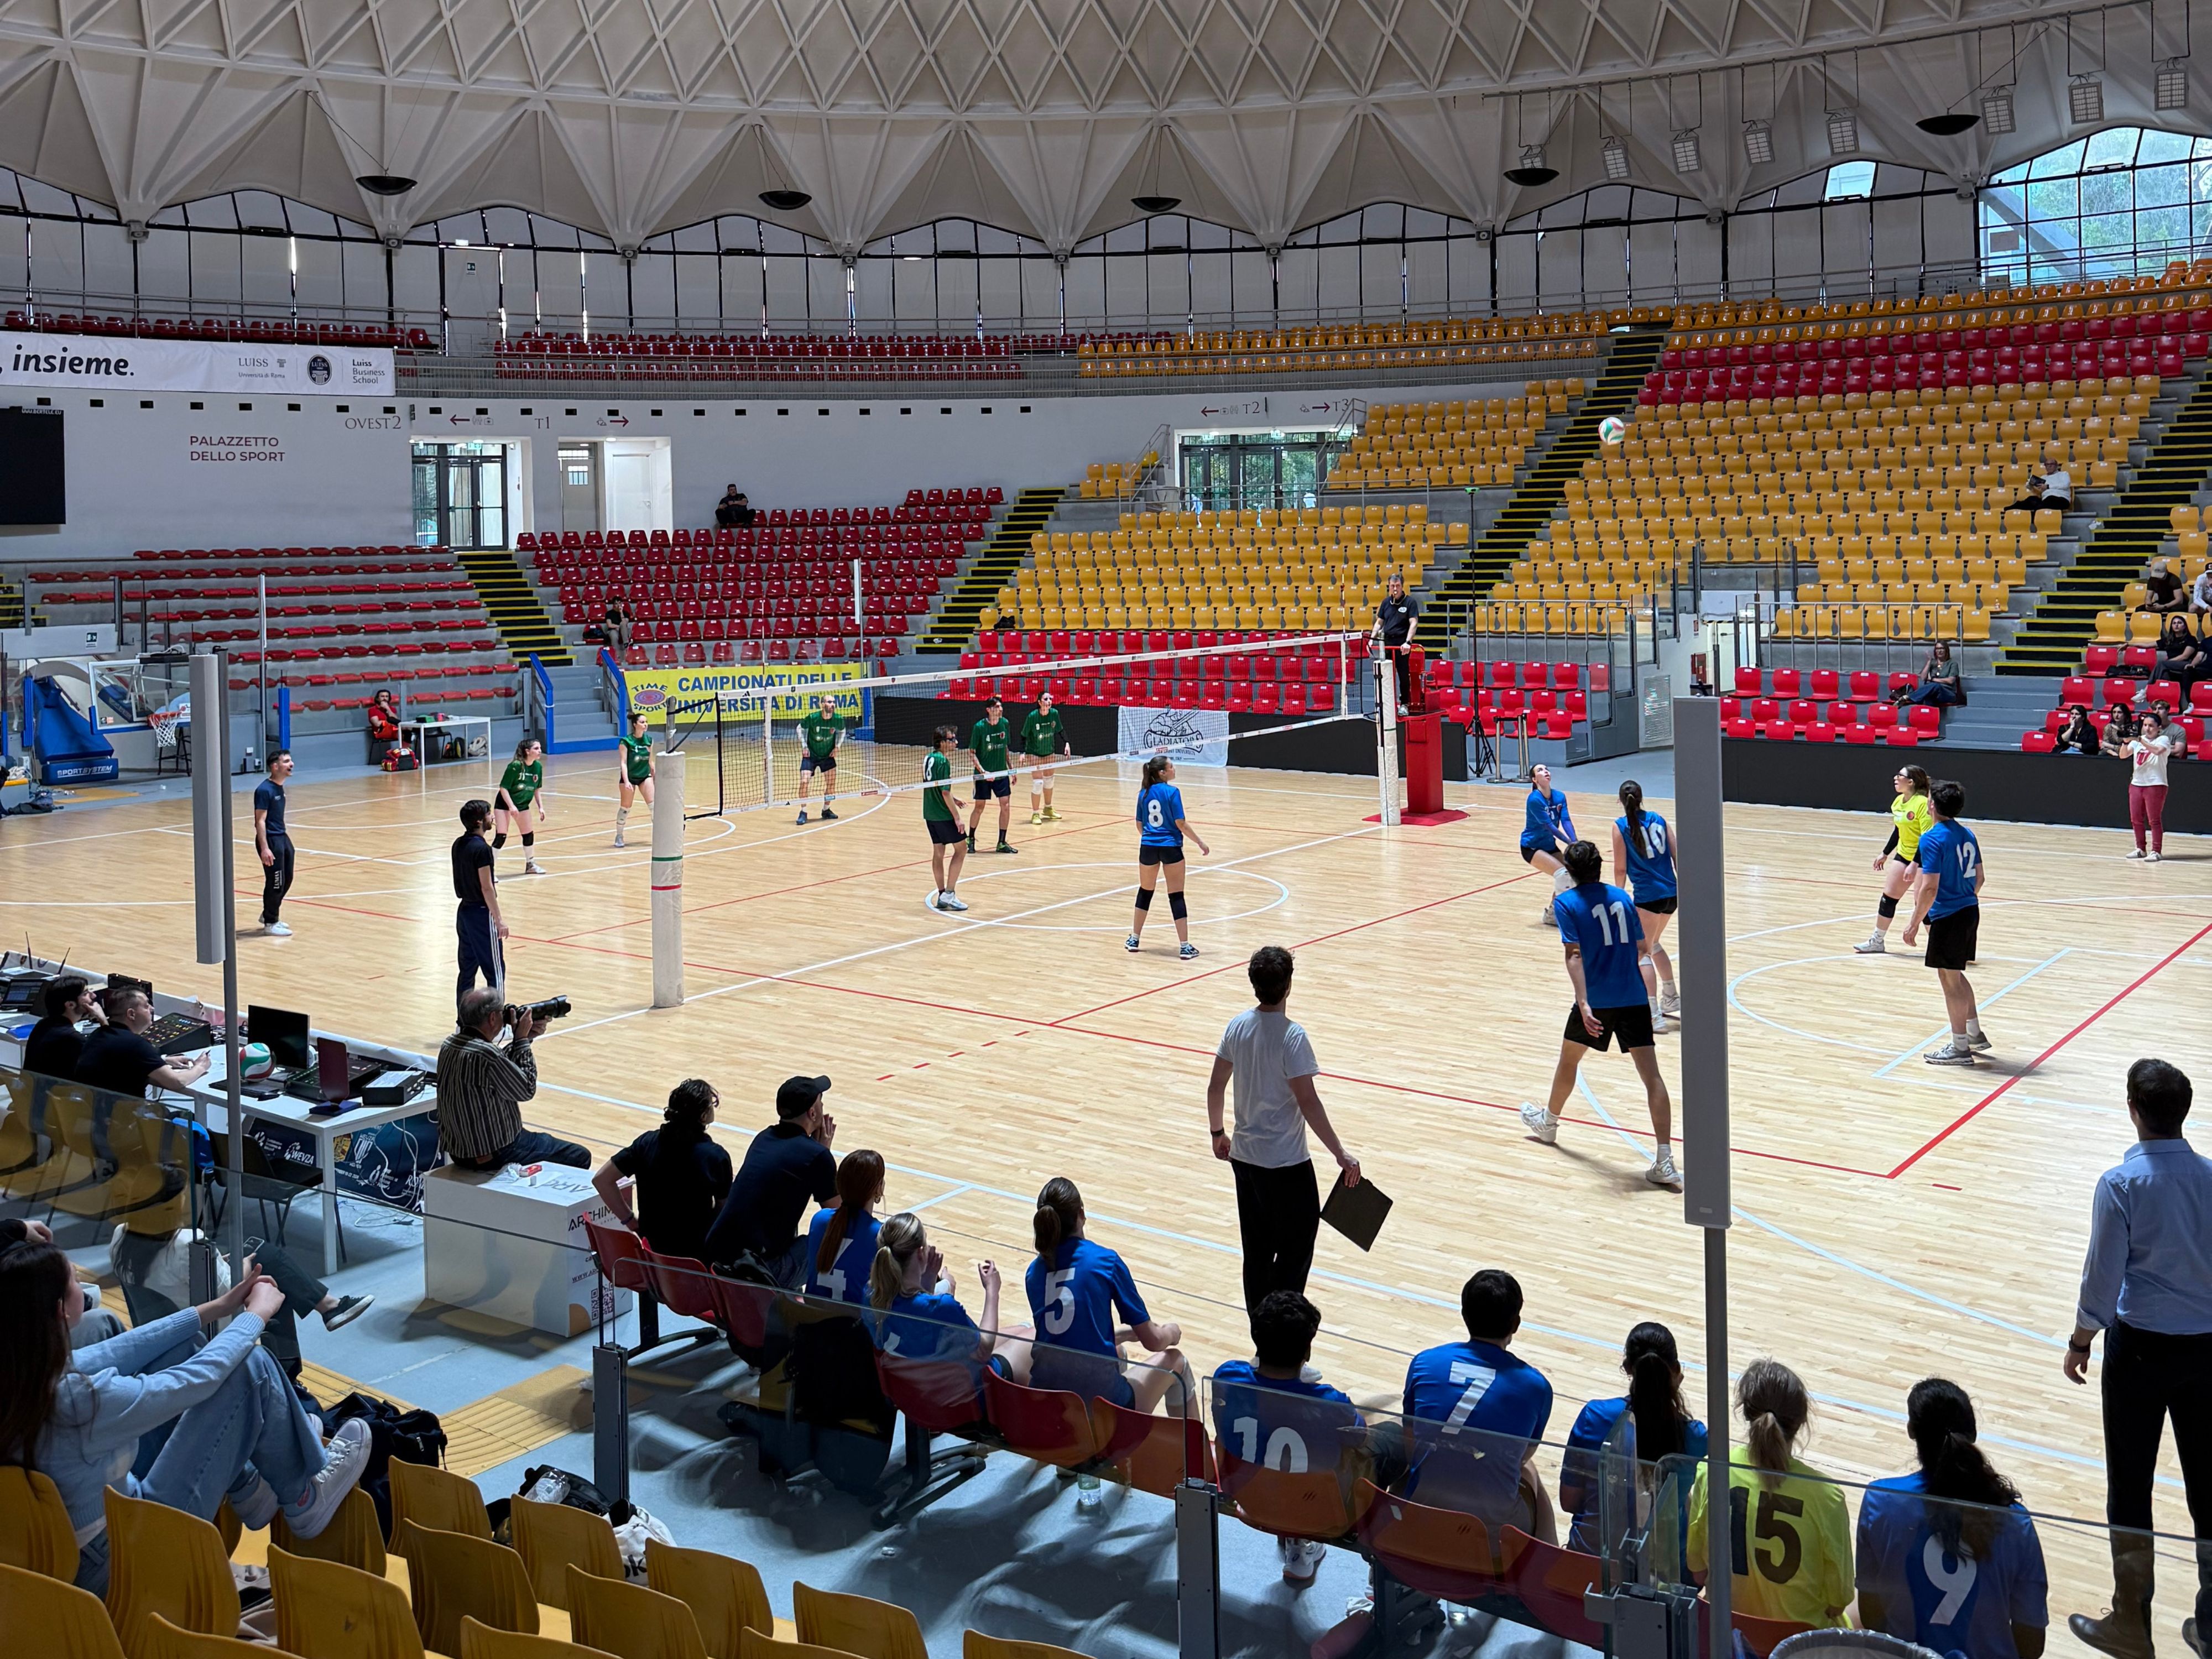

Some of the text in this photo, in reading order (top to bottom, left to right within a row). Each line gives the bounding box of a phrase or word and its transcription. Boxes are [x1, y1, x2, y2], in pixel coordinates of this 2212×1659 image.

[13, 344, 134, 376] insieme.
[238, 358, 268, 367] LUISS
[352, 367, 385, 376] Business
[1243, 401, 1260, 414] T2
[534, 416, 550, 429] T1
[190, 436, 279, 447] PALAZZETTO
[190, 451, 285, 462] DELLO SPORT
[632, 683, 669, 692] TIME
[678, 674, 792, 692] CAMPIONATI
[785, 695, 802, 709] DI
[809, 693, 859, 709] RMA
[1148, 799, 1164, 827] 8
[1641, 822, 1666, 859] 10
[1957, 842, 1976, 878] 12
[1592, 901, 1629, 946] 11
[291, 1150, 314, 1165] WEVZA
[1045, 1267, 1076, 1335] 5
[1449, 1361, 1496, 1434] 7
[1233, 1416, 1309, 1474] 10
[1729, 1486, 1804, 1584] 15
[1922, 1533, 1977, 1625] 9
